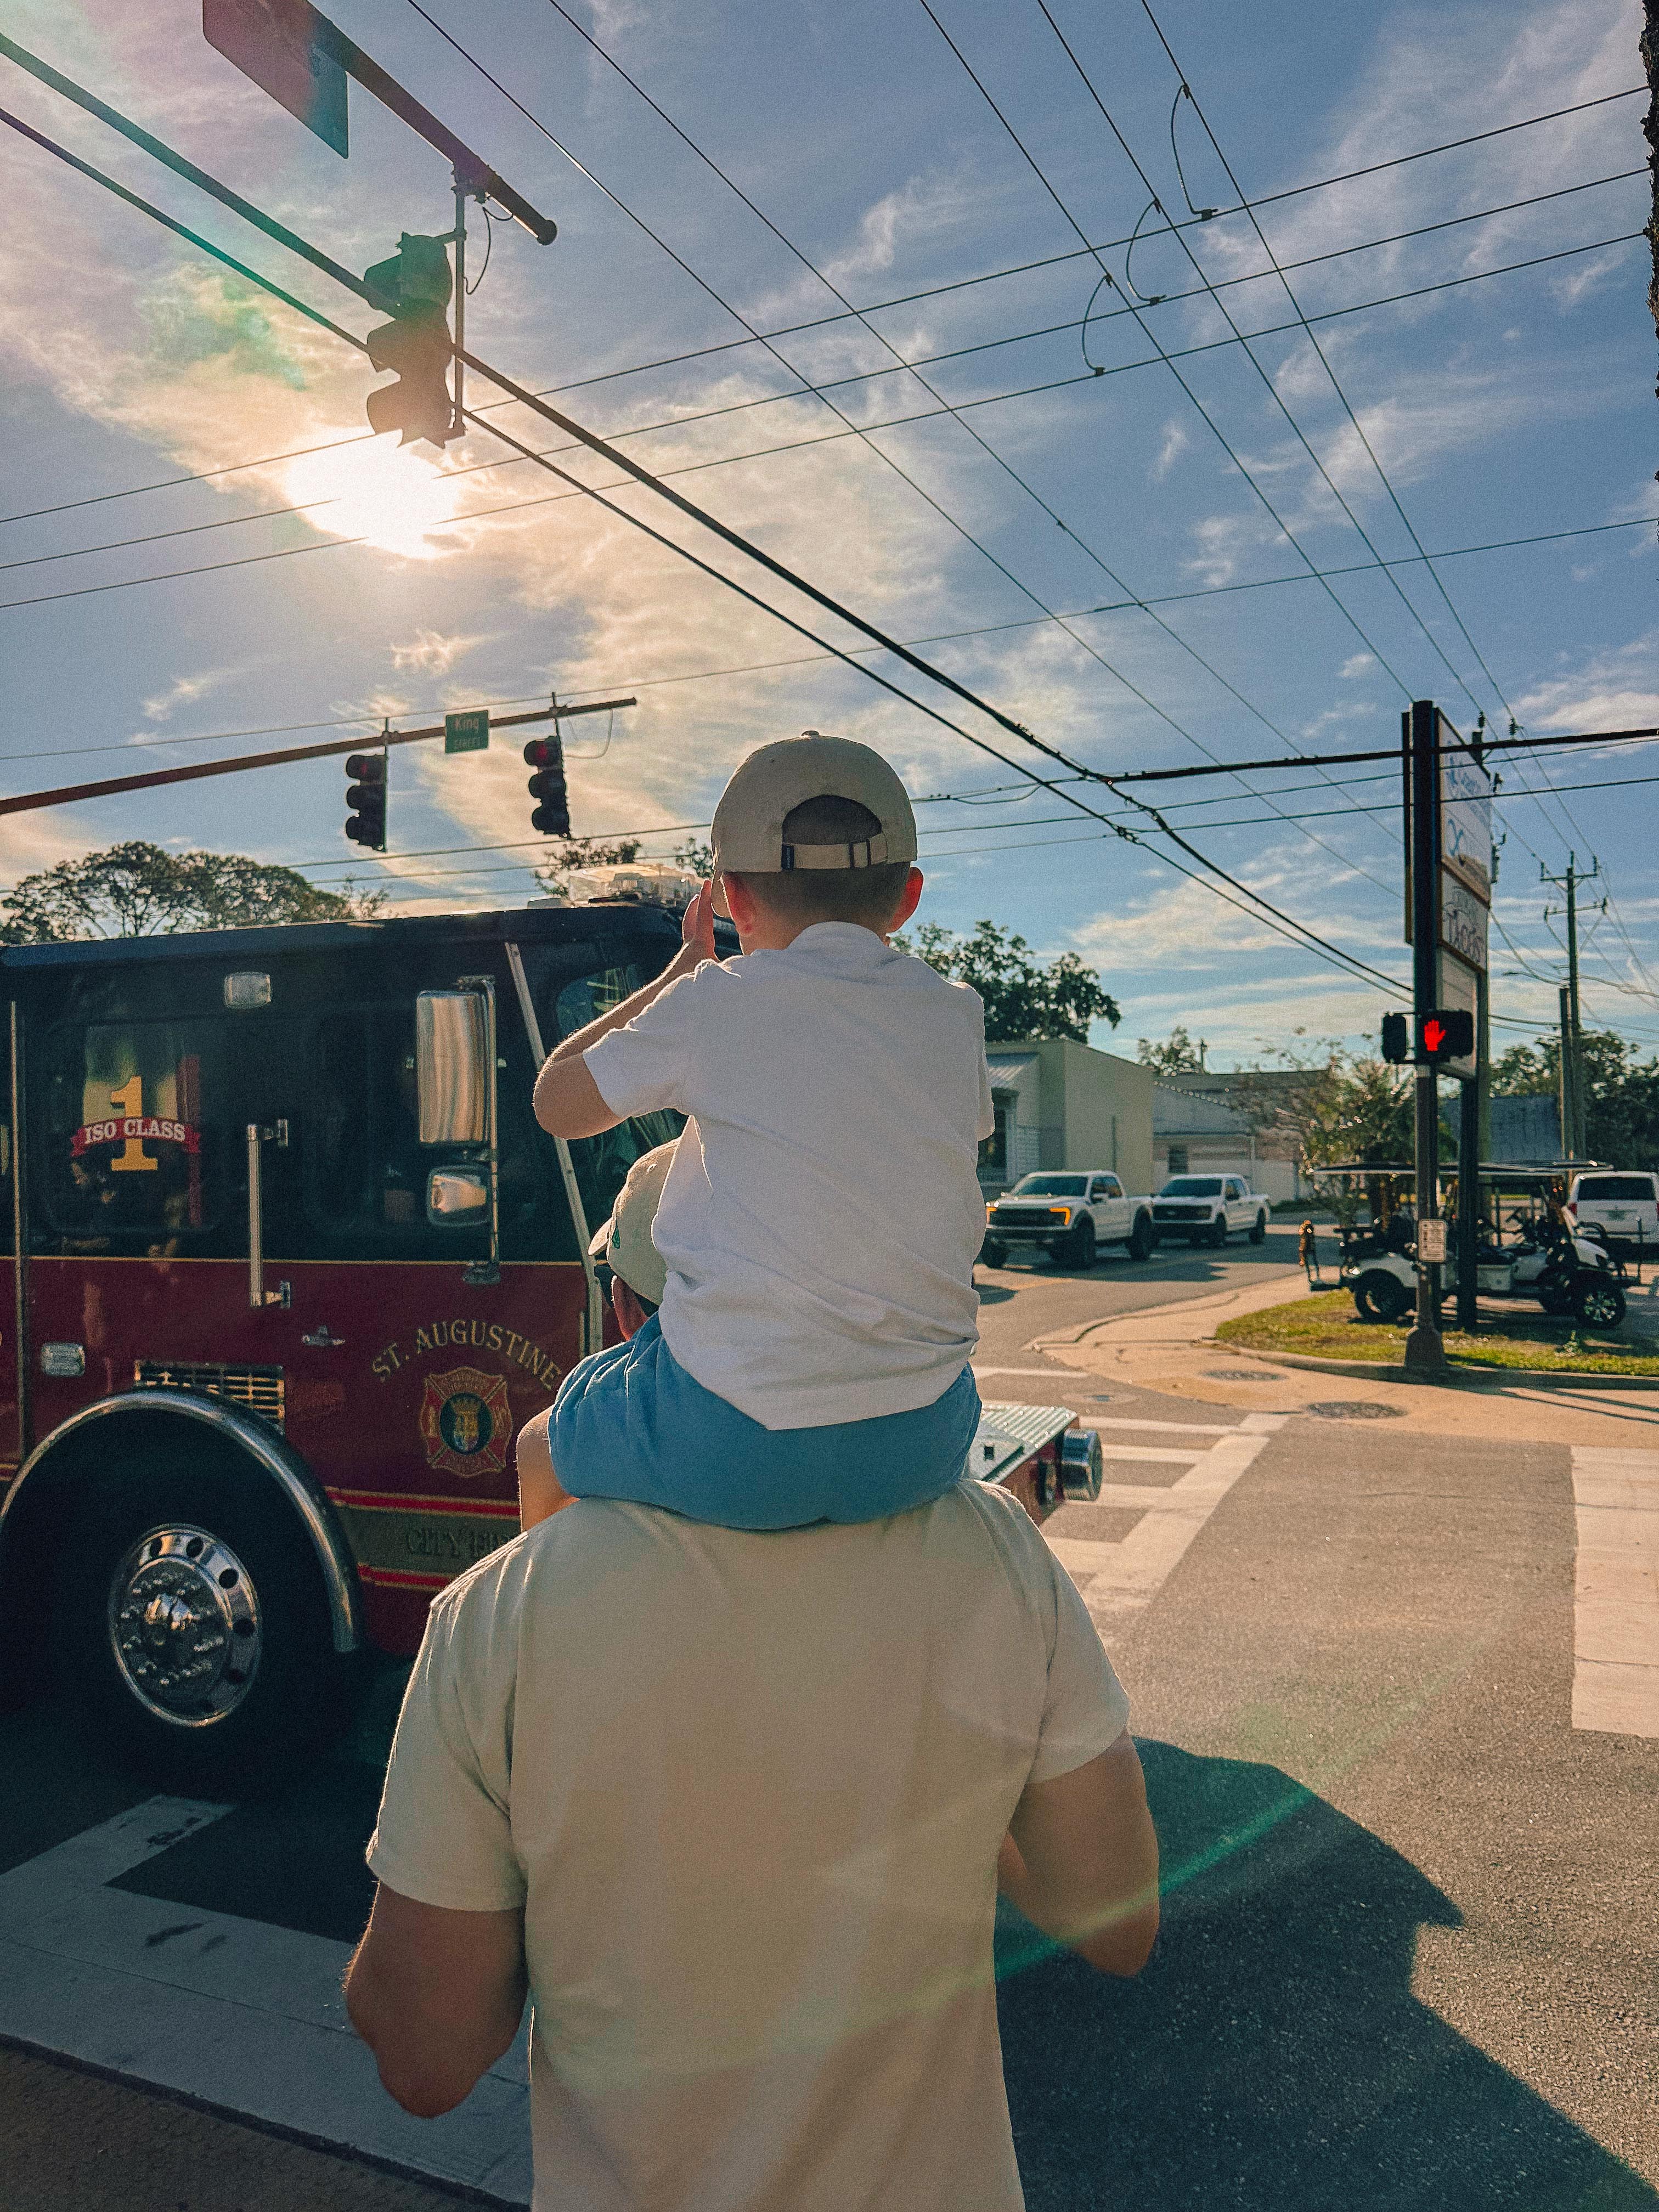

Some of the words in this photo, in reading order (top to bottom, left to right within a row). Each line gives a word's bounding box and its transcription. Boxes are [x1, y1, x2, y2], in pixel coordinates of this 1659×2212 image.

[454, 716, 479, 733] King
[84, 1121, 117, 1144] ISO
[123, 1119, 186, 1142] CLASS
[111, 1075, 158, 1171] 1
[372, 1342, 410, 1383] ST.
[416, 1319, 562, 1391] AUGUSTINE
